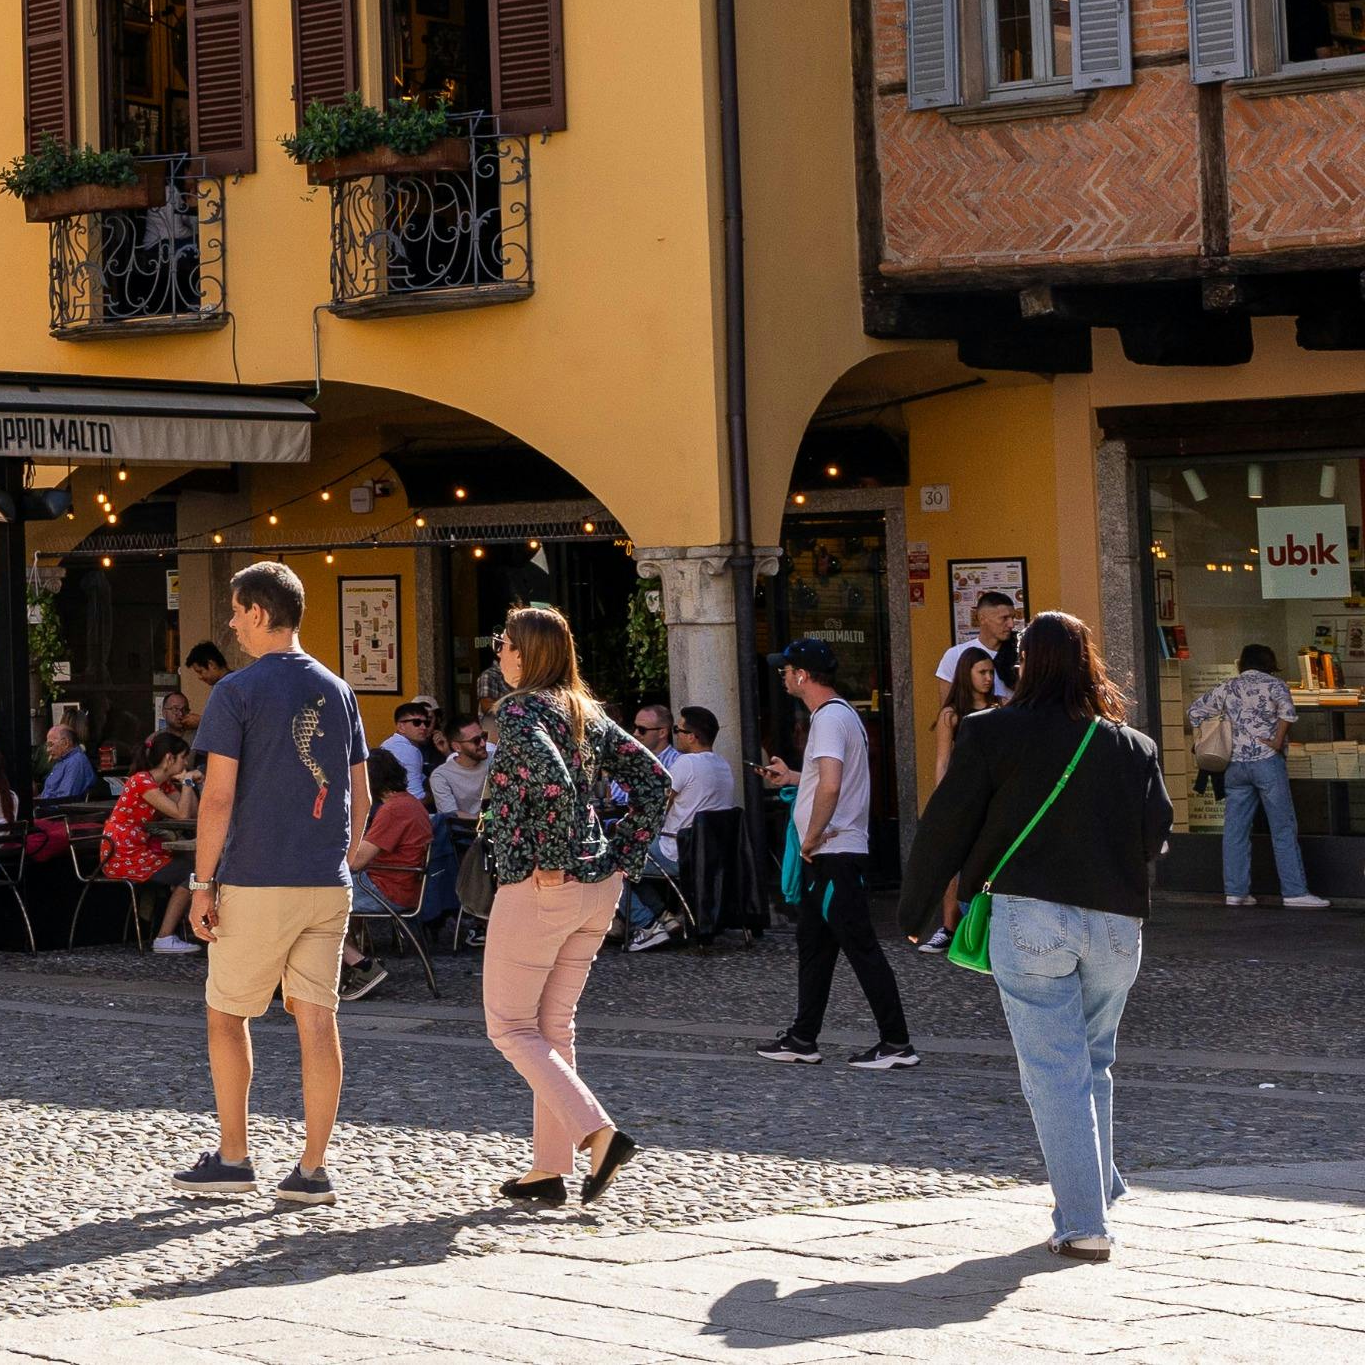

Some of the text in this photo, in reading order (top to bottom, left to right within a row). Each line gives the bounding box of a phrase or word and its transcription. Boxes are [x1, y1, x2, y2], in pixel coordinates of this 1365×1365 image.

[50, 419, 112, 454] MALTO
[925, 491, 943, 506] 30
[1267, 533, 1340, 576] ubik
[835, 630, 864, 643] MALTO
